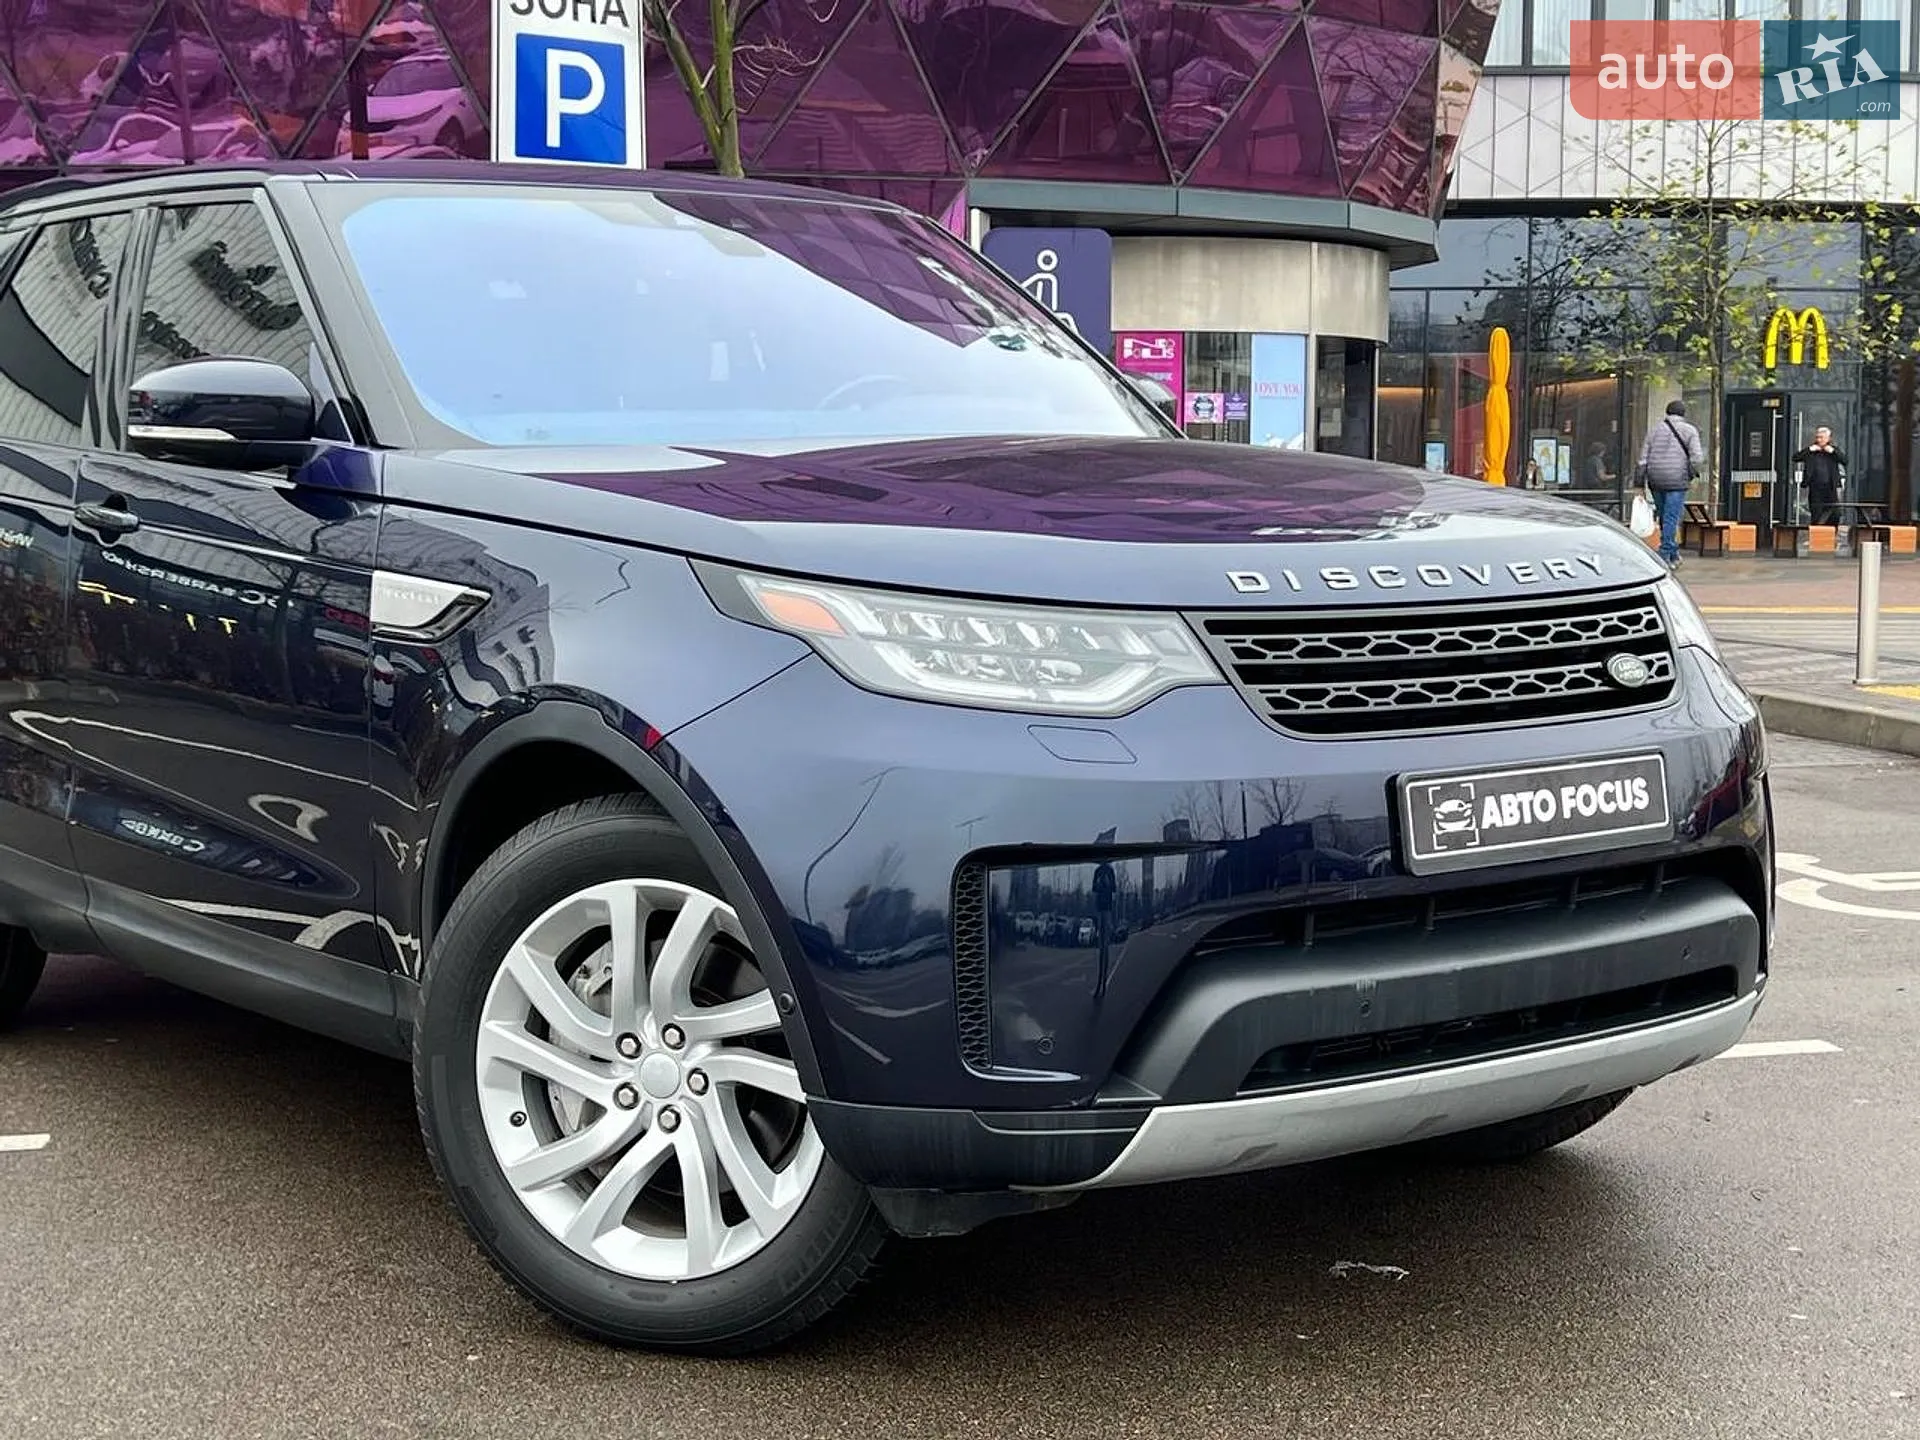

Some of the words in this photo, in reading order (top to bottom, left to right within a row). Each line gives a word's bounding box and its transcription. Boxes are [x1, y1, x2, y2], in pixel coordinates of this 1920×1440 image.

[546, 48, 605, 148] P
[1226, 554, 1603, 594] DISCOVERY
[1481, 788, 1557, 830] АВТО
[1560, 776, 1650, 819] FOCUS
